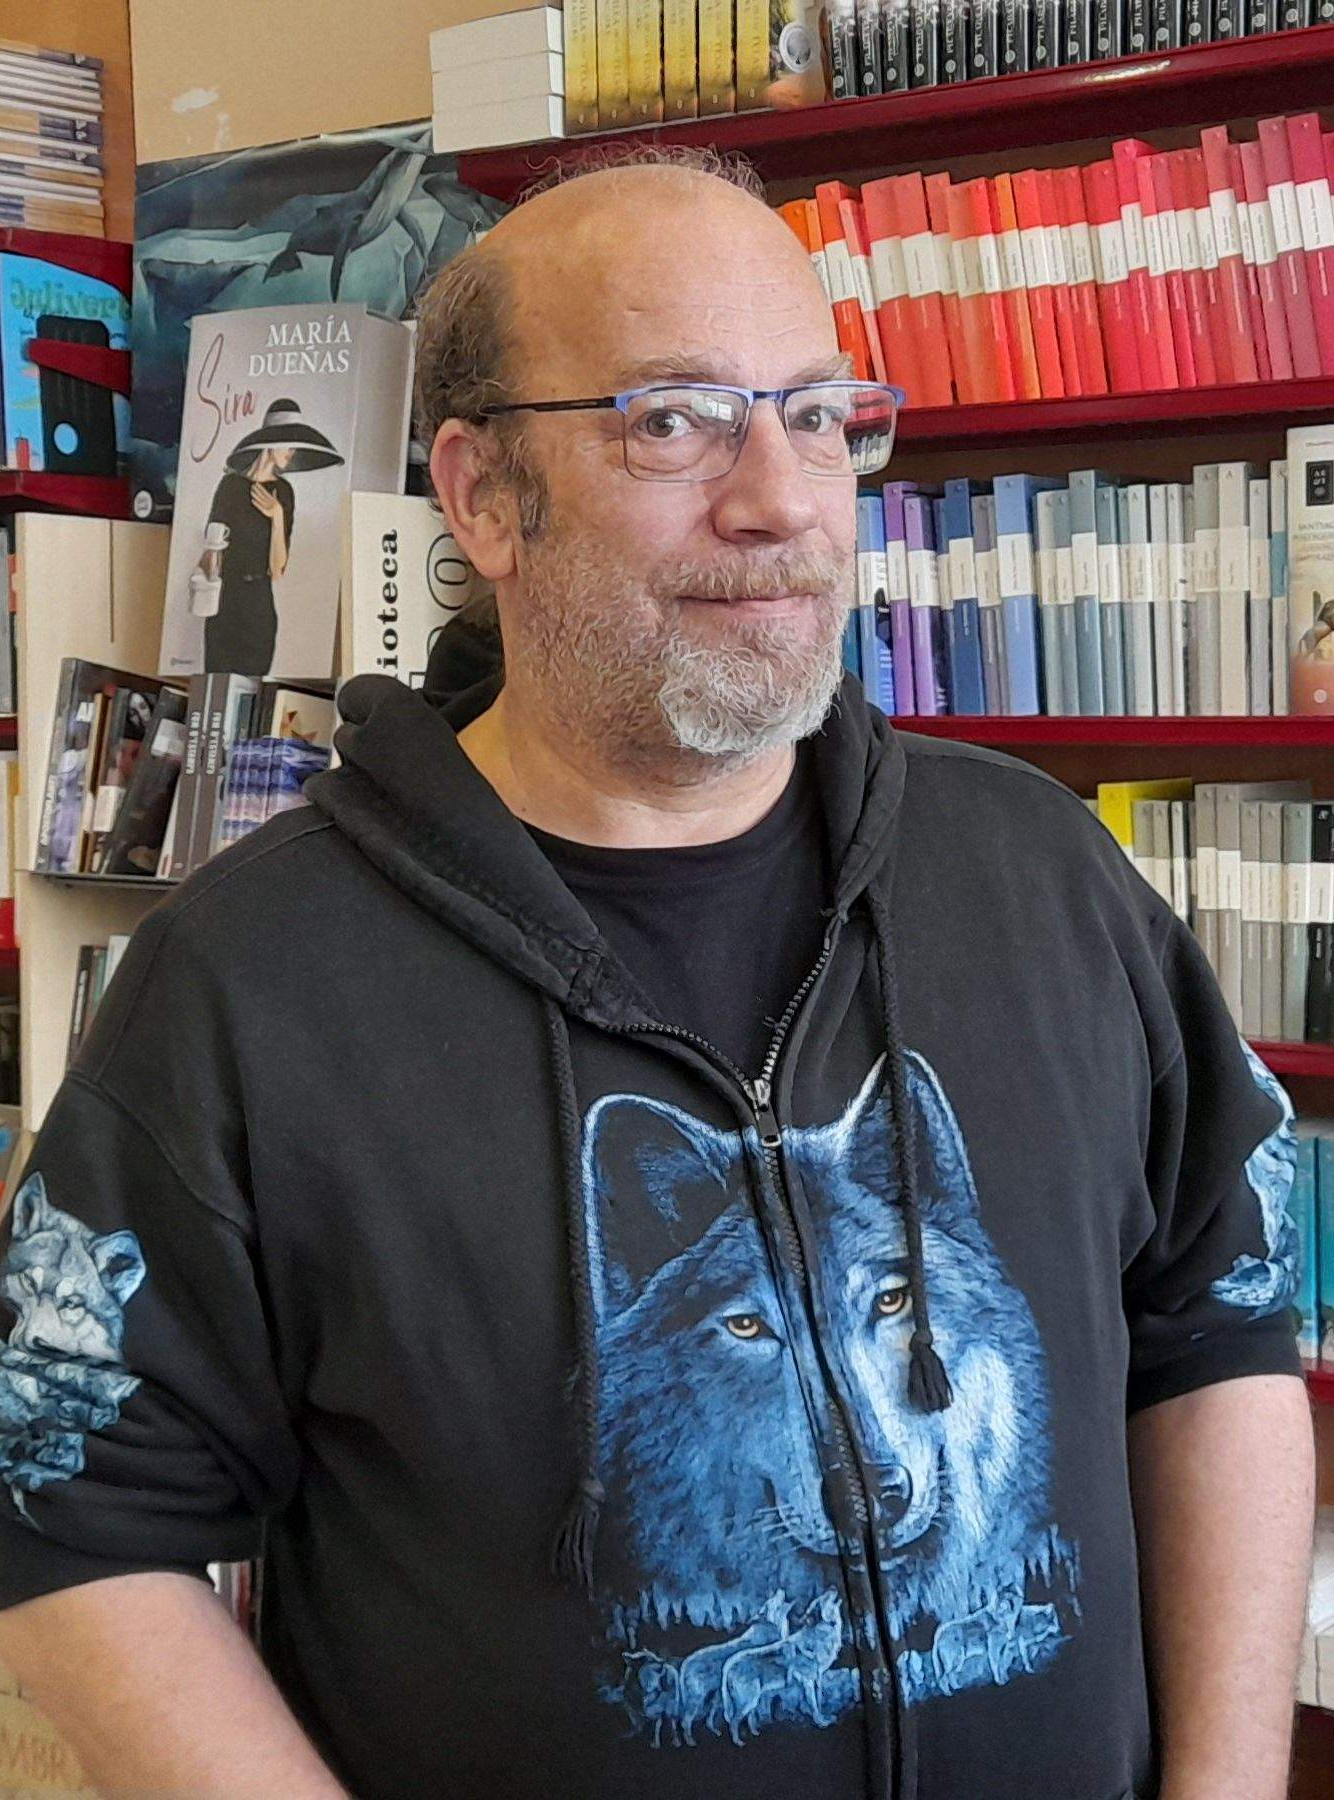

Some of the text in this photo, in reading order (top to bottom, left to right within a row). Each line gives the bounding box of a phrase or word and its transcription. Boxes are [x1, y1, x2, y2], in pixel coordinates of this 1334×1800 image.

[265, 315, 352, 348] MARÍA
[247, 347, 350, 378] DUEÑAS
[191, 332, 257, 463] Sira
